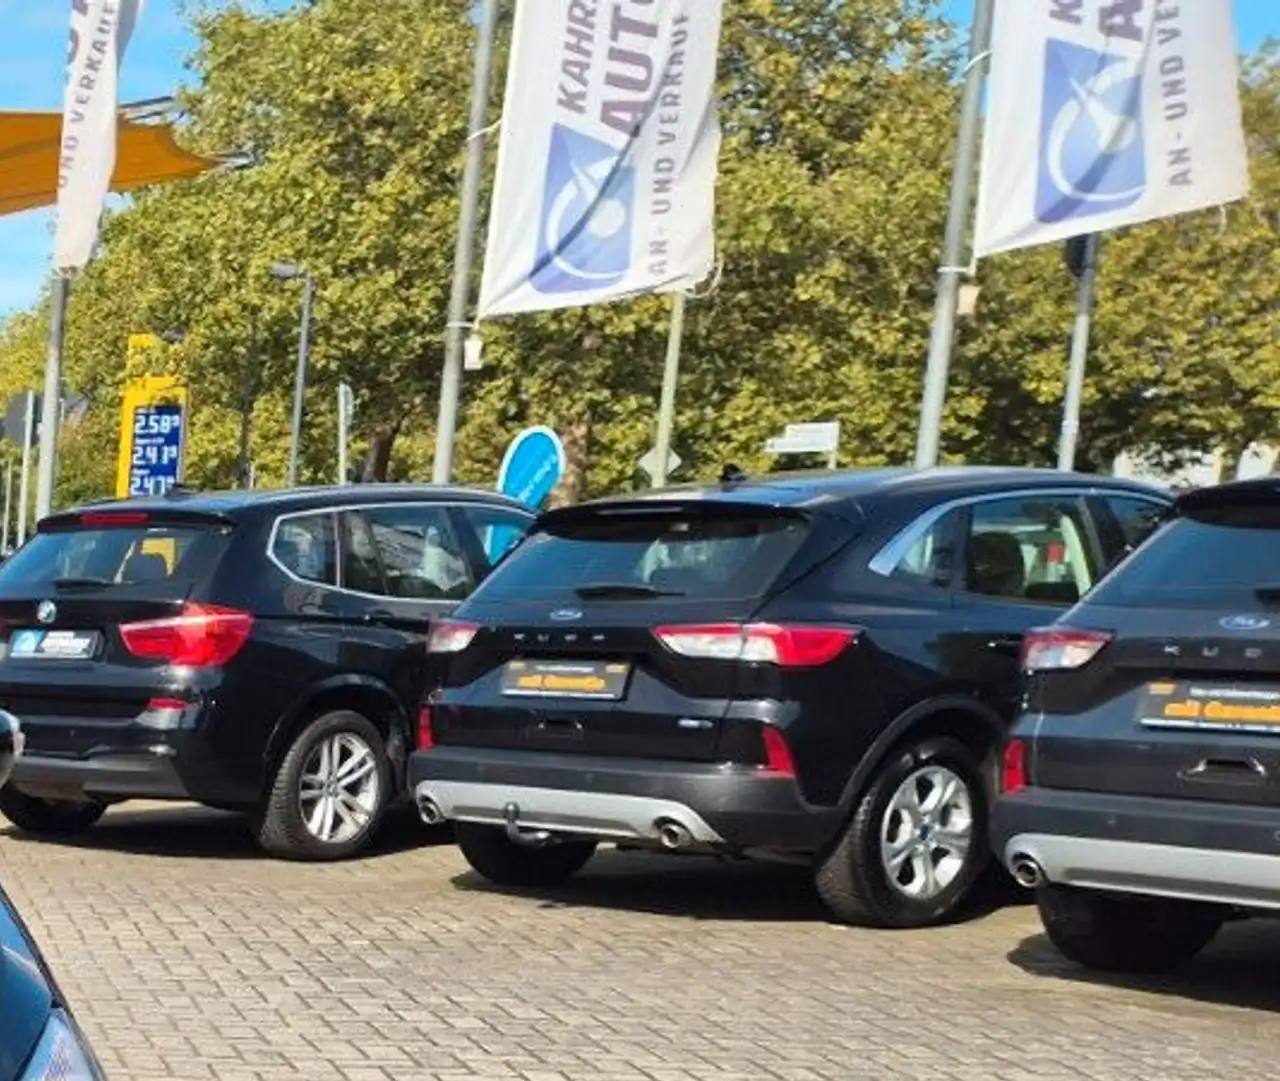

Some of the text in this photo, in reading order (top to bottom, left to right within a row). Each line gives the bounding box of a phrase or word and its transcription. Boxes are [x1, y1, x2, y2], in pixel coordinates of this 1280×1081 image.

[600, 0, 659, 138] AUT
[1159, 55, 1188, 121] UND
[651, 157, 676, 215] UND
